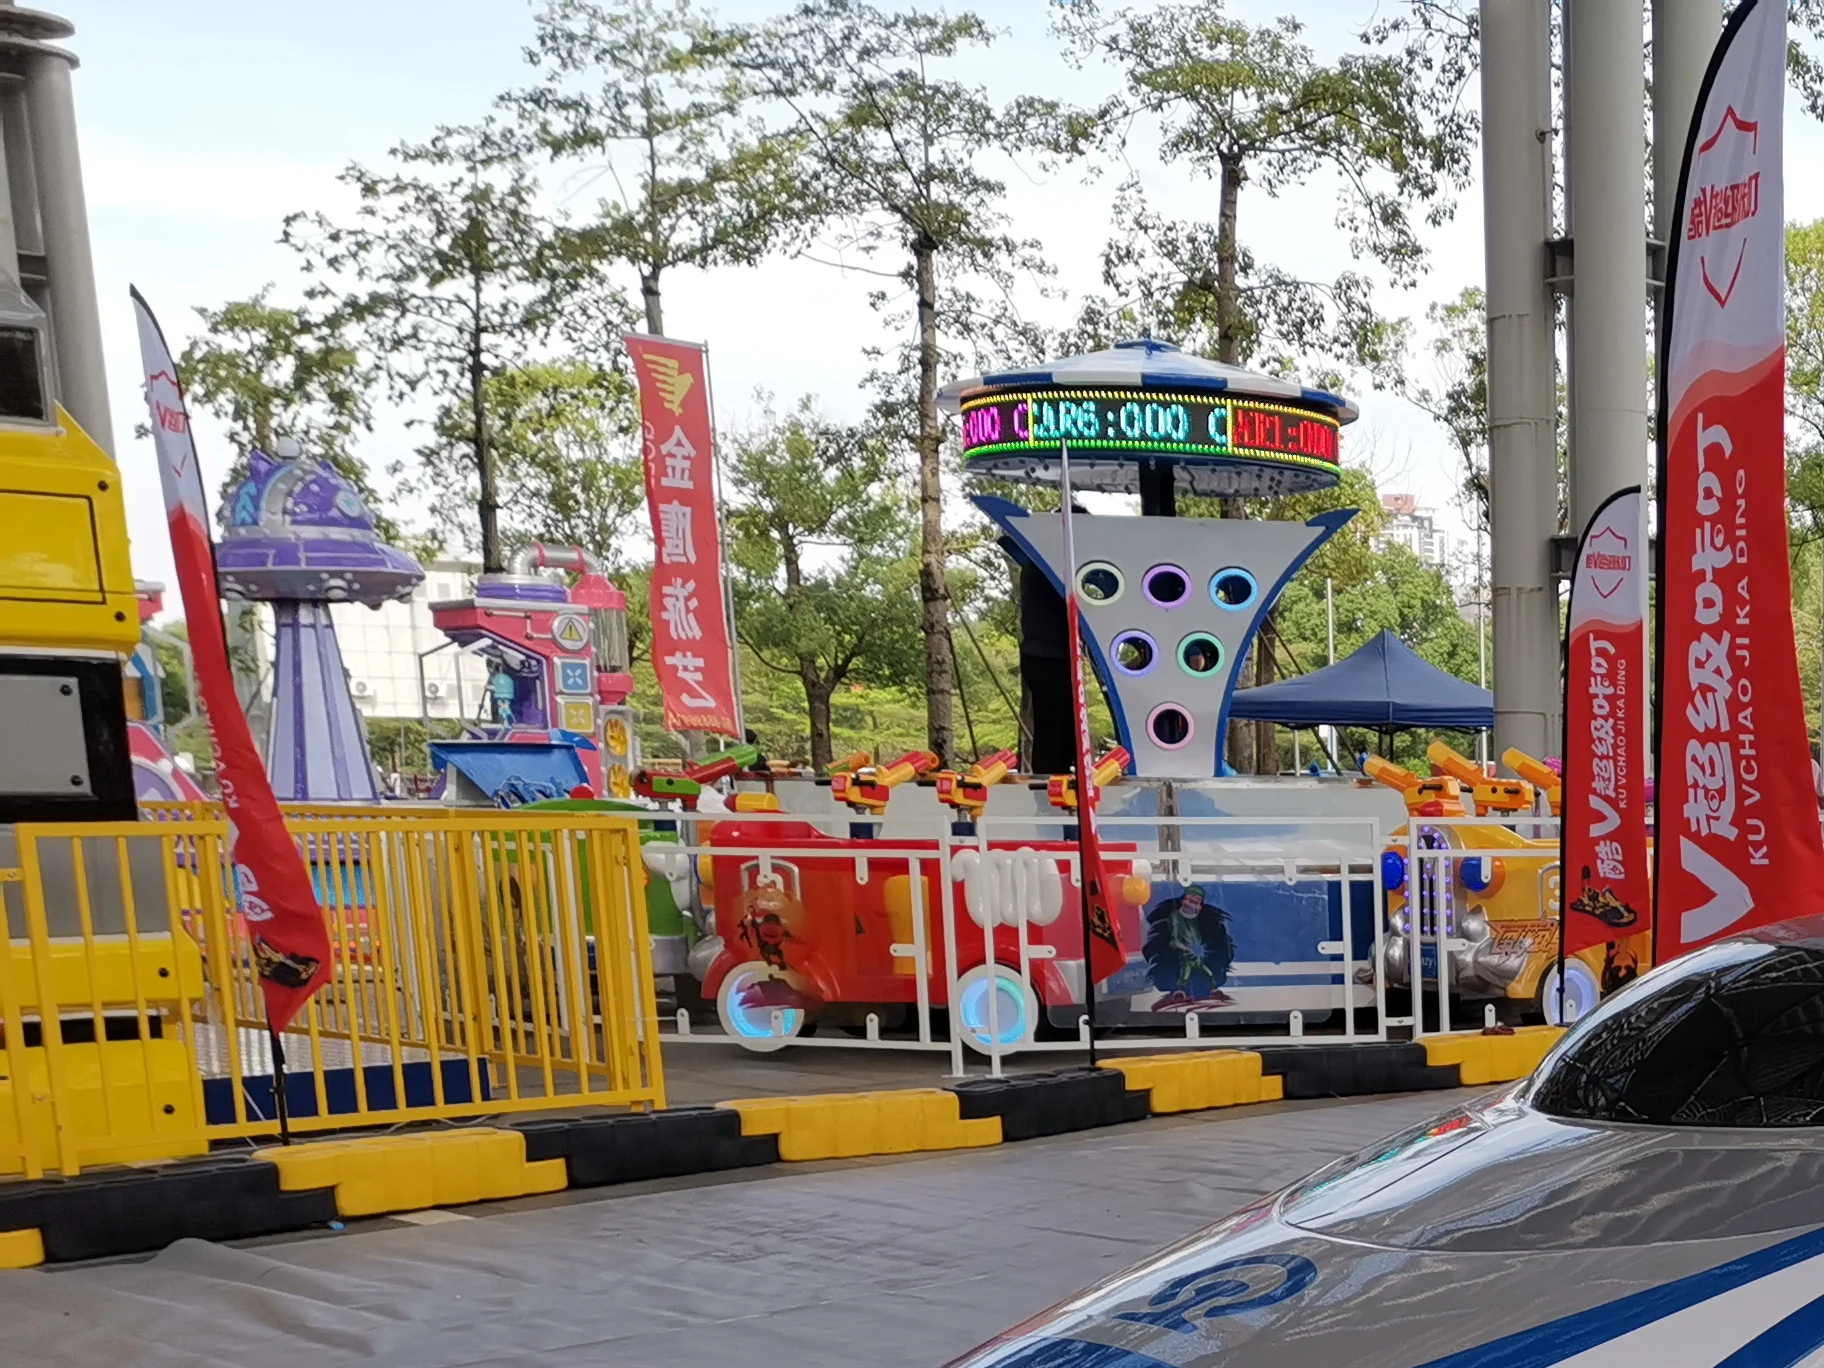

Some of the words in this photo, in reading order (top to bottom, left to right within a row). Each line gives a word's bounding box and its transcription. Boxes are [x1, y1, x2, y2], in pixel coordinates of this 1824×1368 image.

[1736, 468, 1748, 564] DING
[1737, 577, 1751, 625] KA
[1736, 637, 1751, 668] JI
[1616, 659, 1626, 695] DING
[1616, 698, 1625, 717] KA
[1617, 721, 1625, 732] JI
[1588, 632, 1627, 880] 酷V超级咔叮
[1617, 735, 1627, 786] VCHAO
[1737, 678, 1762, 803] VCHAO
[1618, 788, 1627, 808] KU
[1746, 817, 1769, 866] KU
